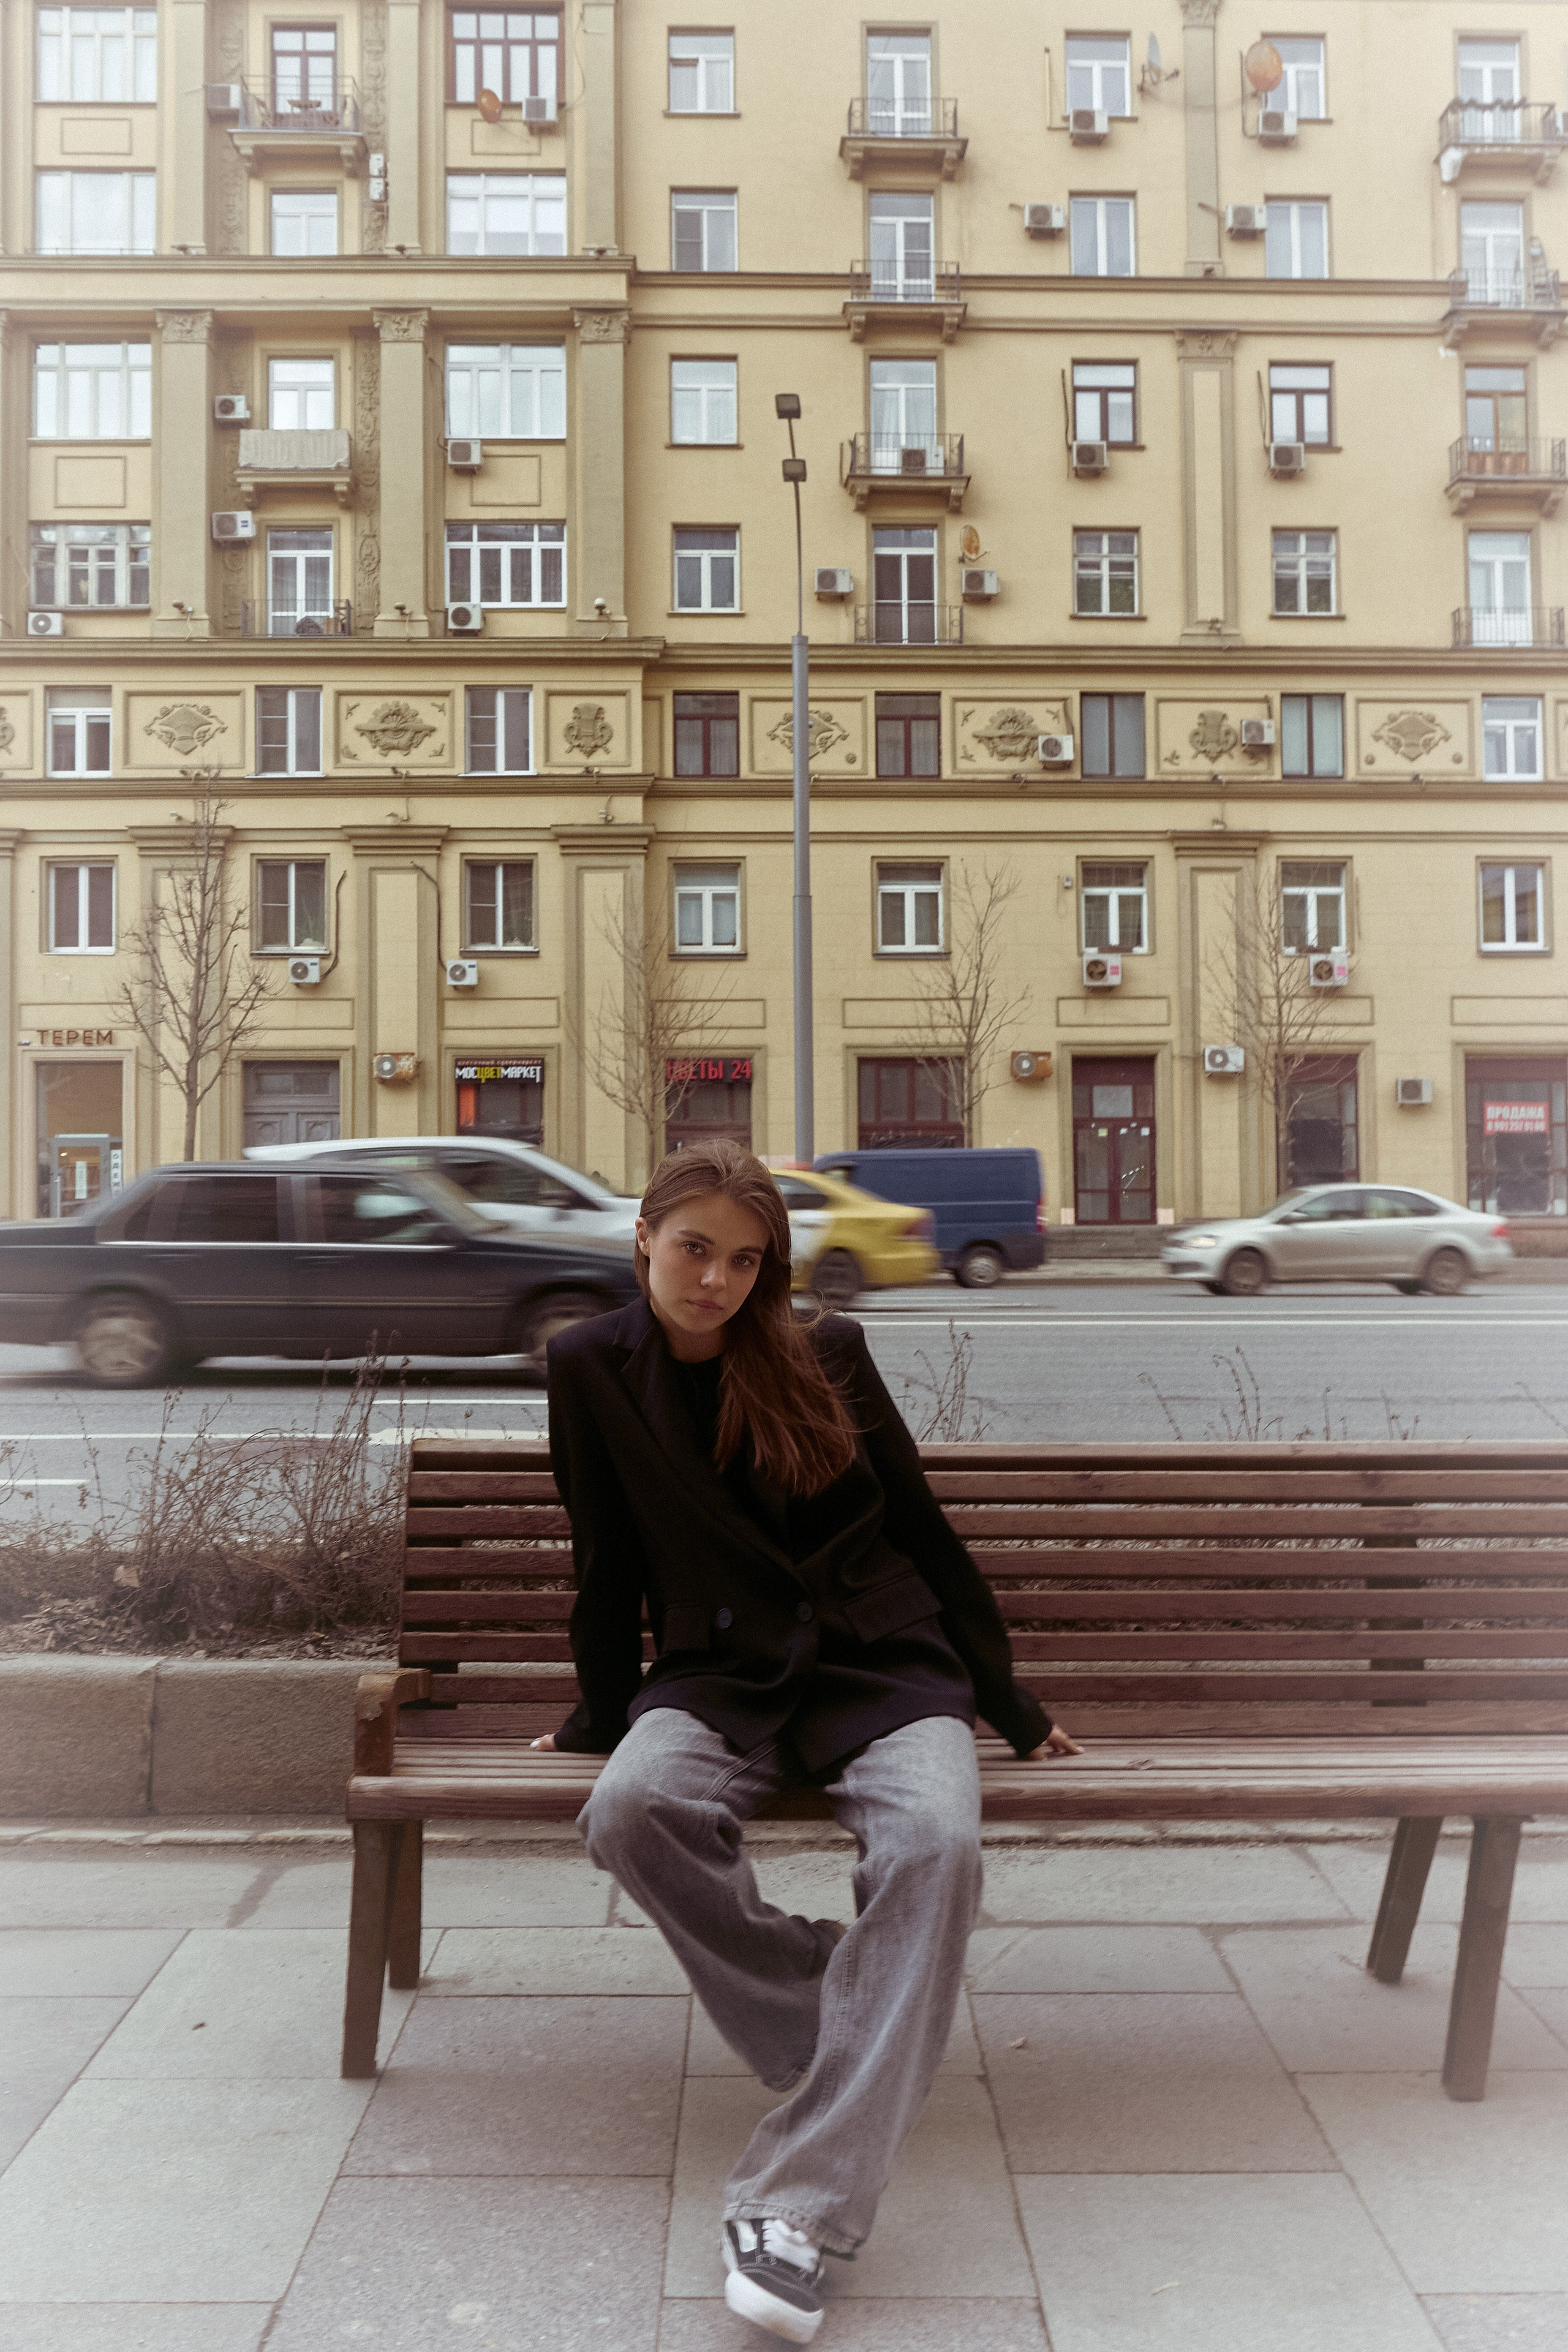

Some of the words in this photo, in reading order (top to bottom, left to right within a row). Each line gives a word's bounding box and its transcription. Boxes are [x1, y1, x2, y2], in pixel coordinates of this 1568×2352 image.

[37, 1029, 113, 1046] ТЕРЕМ
[455, 1066, 542, 1084] МОСЦВЕТМАРКЕТ
[731, 1060, 751, 1079] 24
[1487, 1106, 1544, 1120] ПРОДАЖА
[111, 1153, 121, 1194] ОДЕЖ
